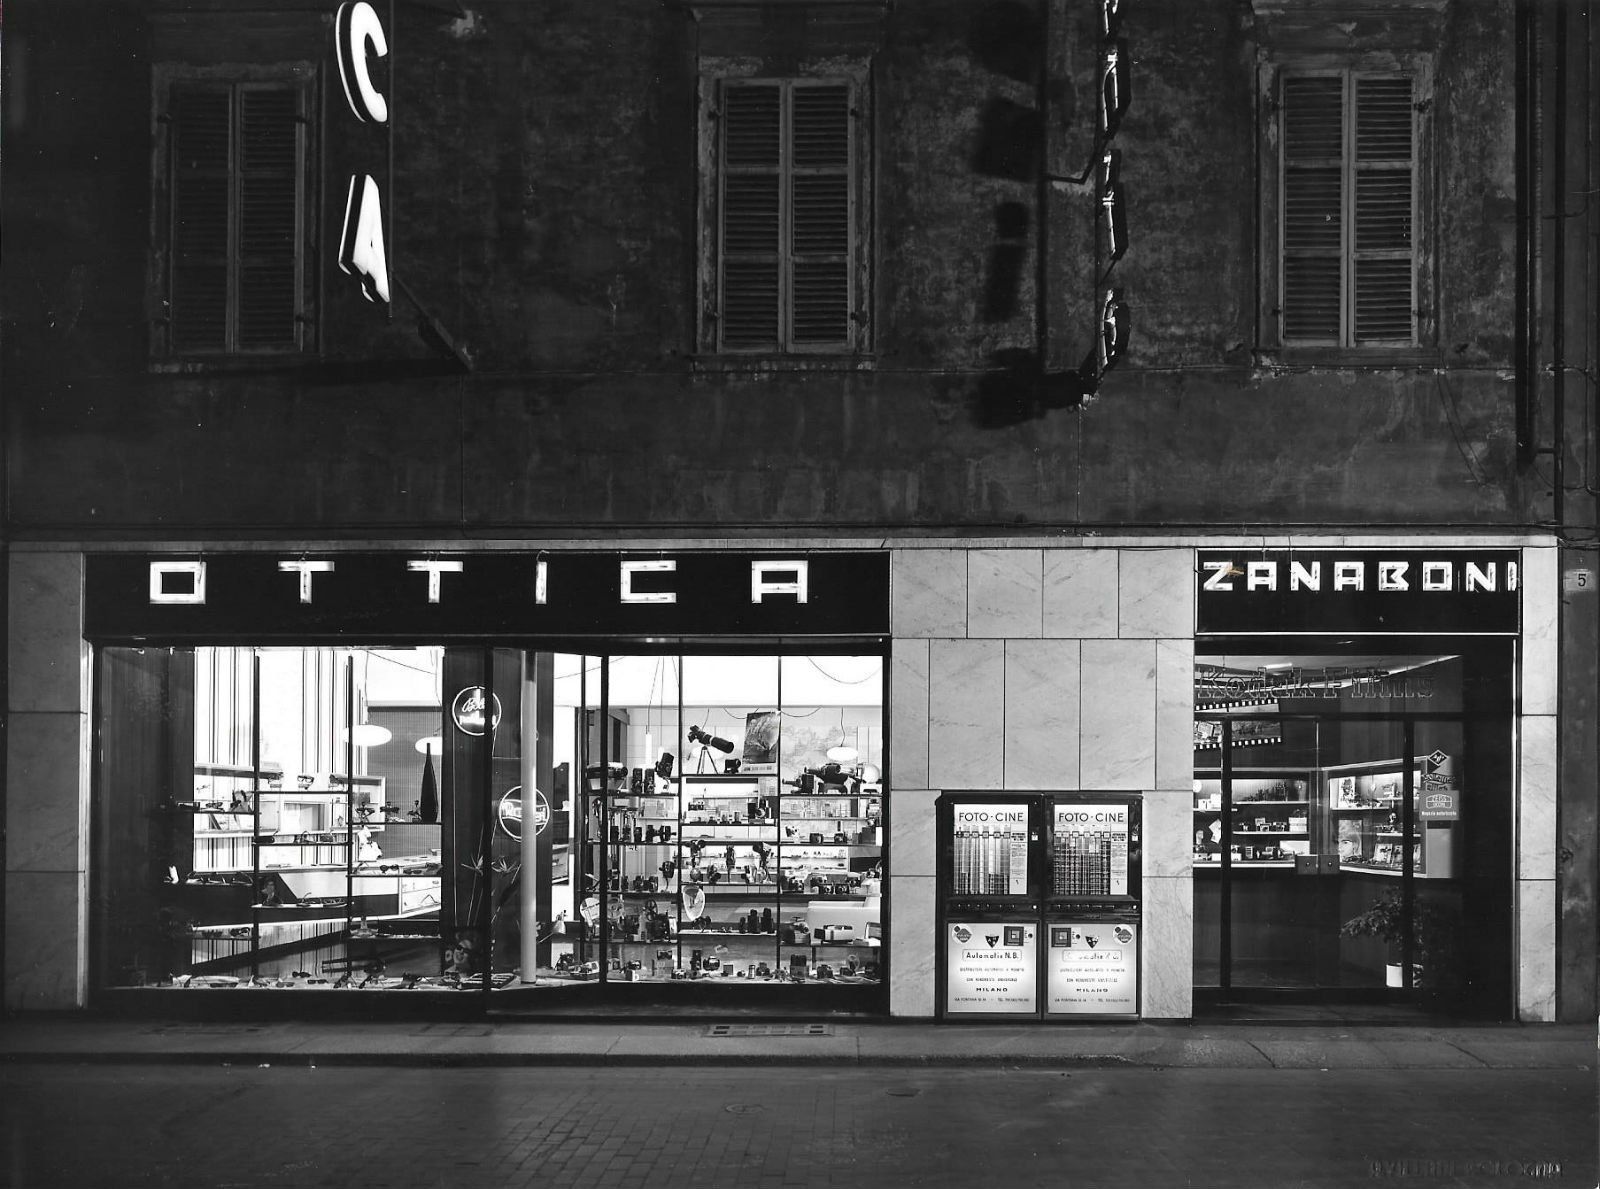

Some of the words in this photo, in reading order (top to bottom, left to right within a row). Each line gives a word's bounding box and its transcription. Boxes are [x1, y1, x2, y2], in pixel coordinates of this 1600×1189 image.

[150, 561, 807, 603] OTTICA
[1204, 562, 1516, 591] ZANABONI
[1578, 573, 1587, 587] 5
[959, 812, 989, 822] FOTO
[995, 812, 1024, 822] CINE
[1058, 812, 1089, 823] FOTO
[1095, 812, 1124, 823] CINE
